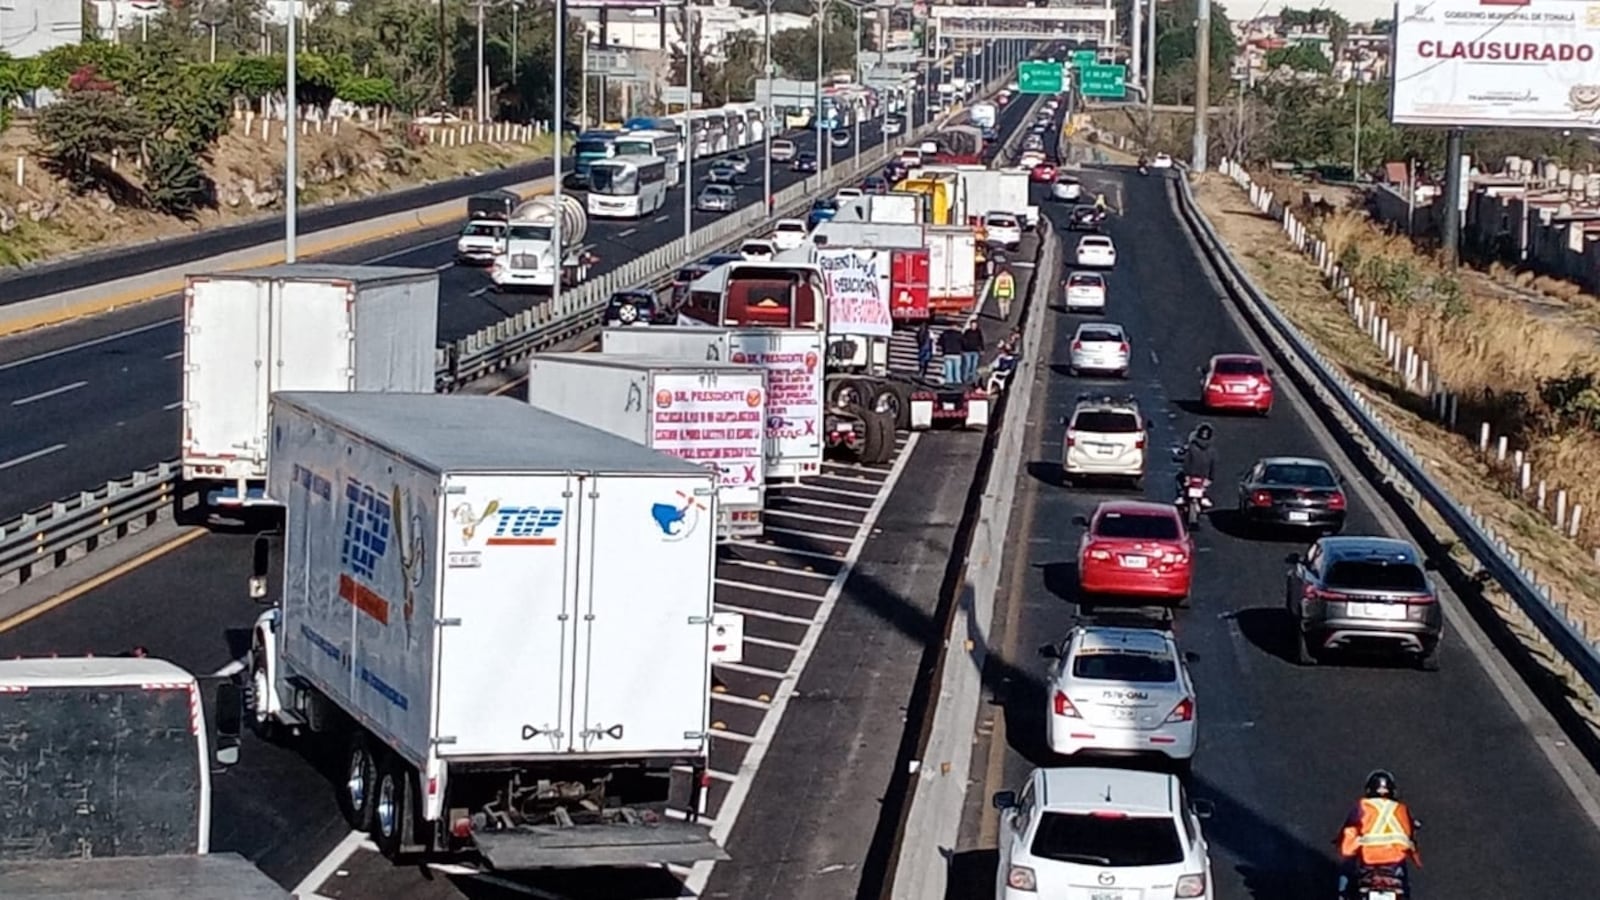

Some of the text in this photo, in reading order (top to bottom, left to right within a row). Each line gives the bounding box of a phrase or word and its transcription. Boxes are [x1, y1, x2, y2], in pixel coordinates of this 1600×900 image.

[1444, 10, 1486, 20] GOBIERNO
[1488, 11, 1530, 21] MUNICIPAL
[1531, 12, 1541, 21] DE
[1543, 11, 1575, 21] TONALÁ
[1417, 40, 1594, 62] CLAUSURADO
[761, 353, 804, 363] PRESIDENTE
[691, 391, 745, 401] PRESIDENTE
